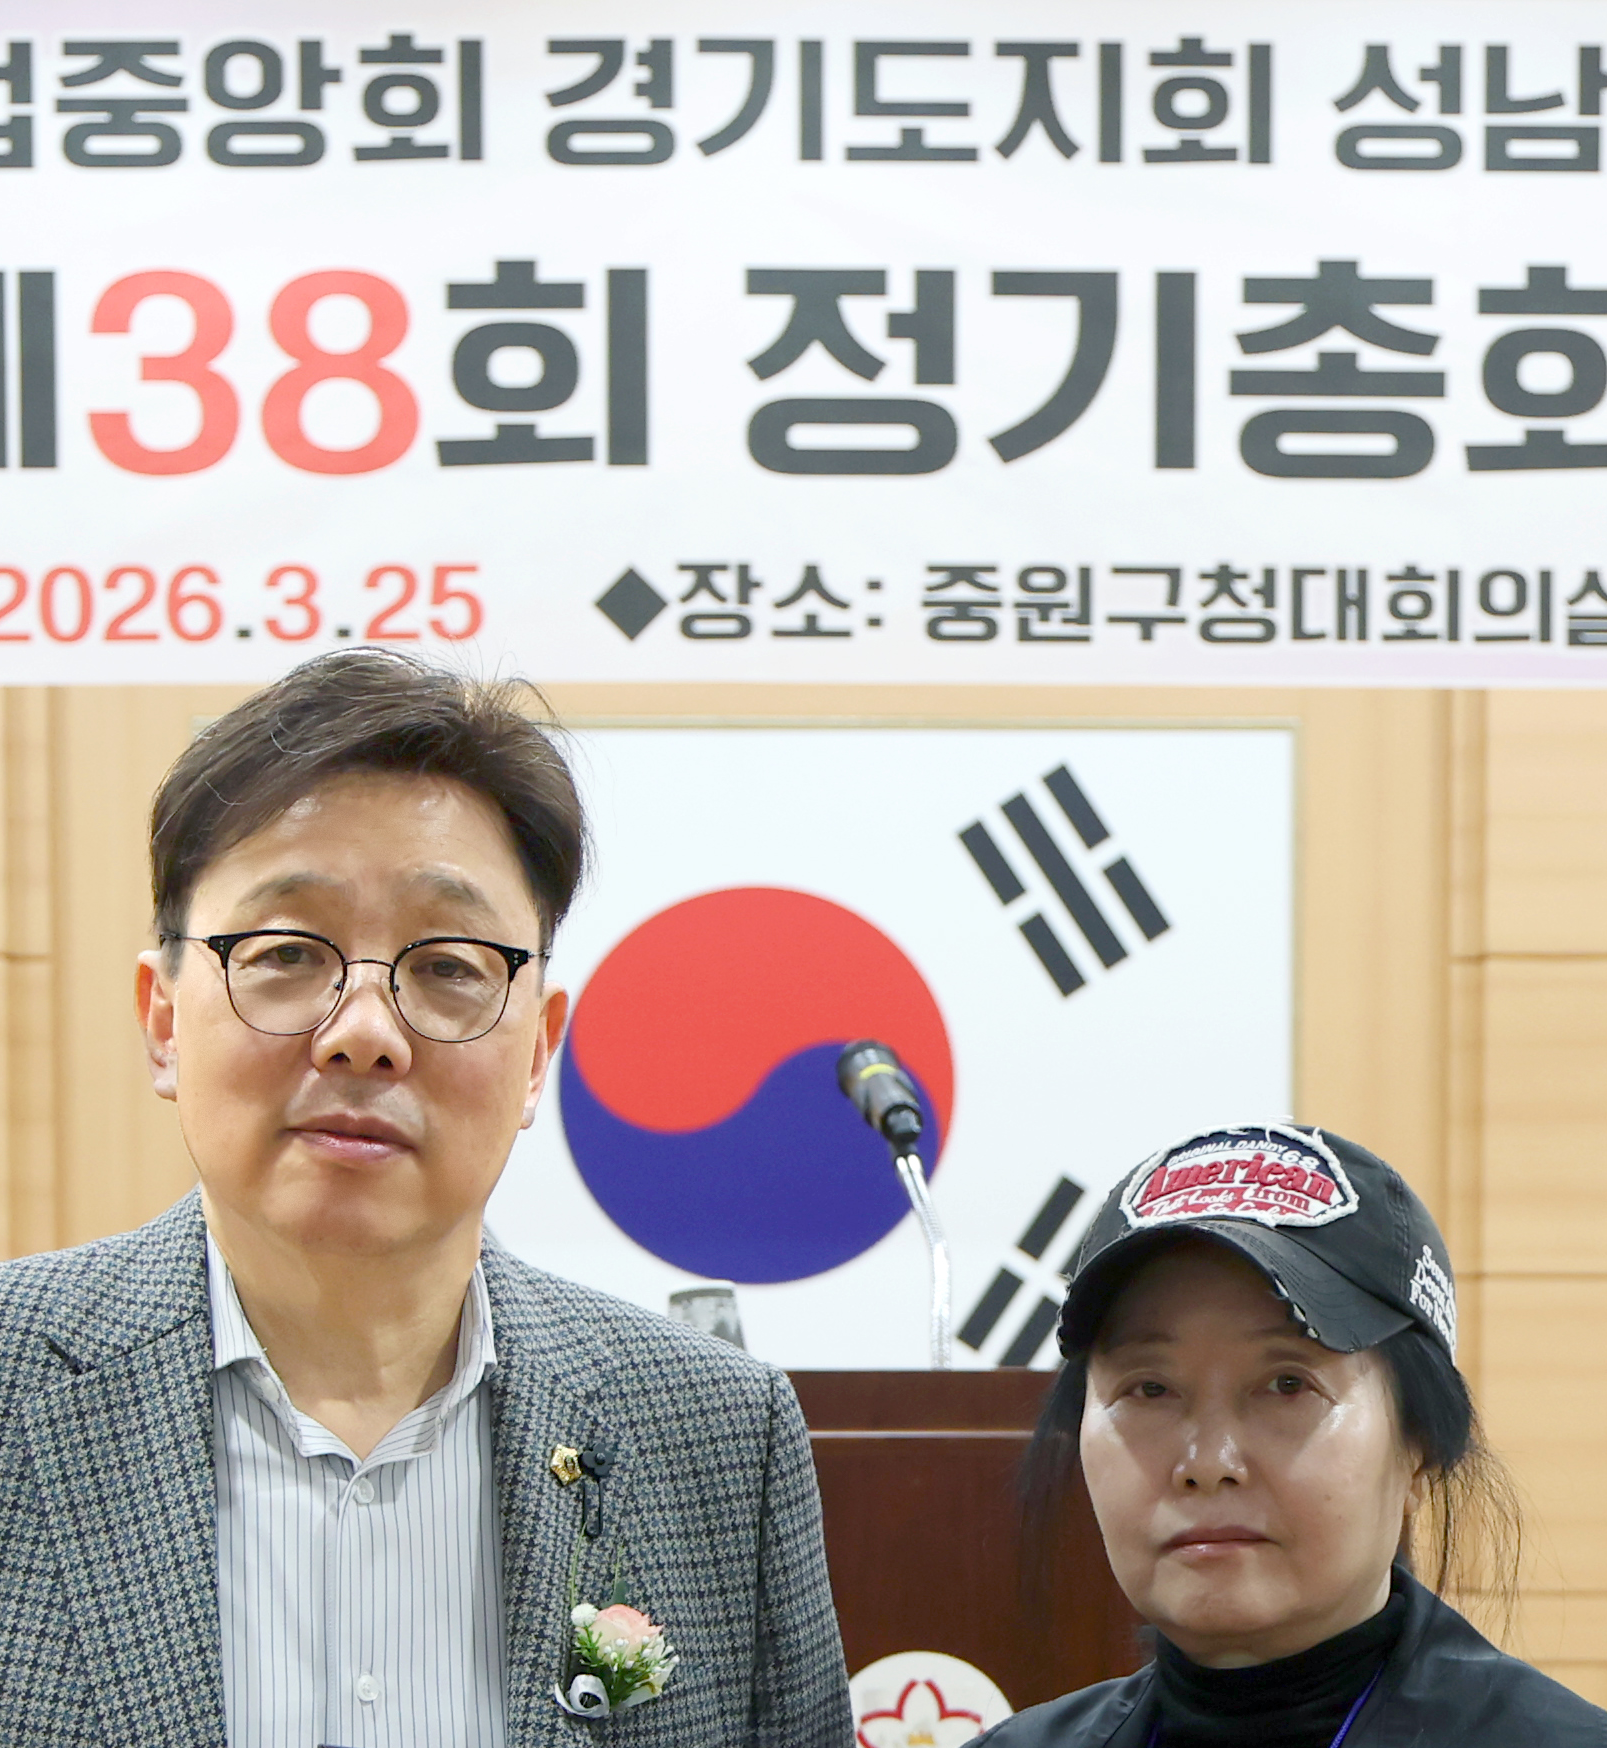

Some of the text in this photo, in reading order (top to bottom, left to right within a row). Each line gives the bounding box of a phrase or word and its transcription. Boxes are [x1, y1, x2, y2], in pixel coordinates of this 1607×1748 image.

[543, 35, 1275, 168] 경기도지회
[675, 562, 884, 642] 장소:
[1137, 1153, 1335, 1210] American
[1167, 1140, 1235, 1167] ORIGINAL
[1280, 1150, 1320, 1170] 68
